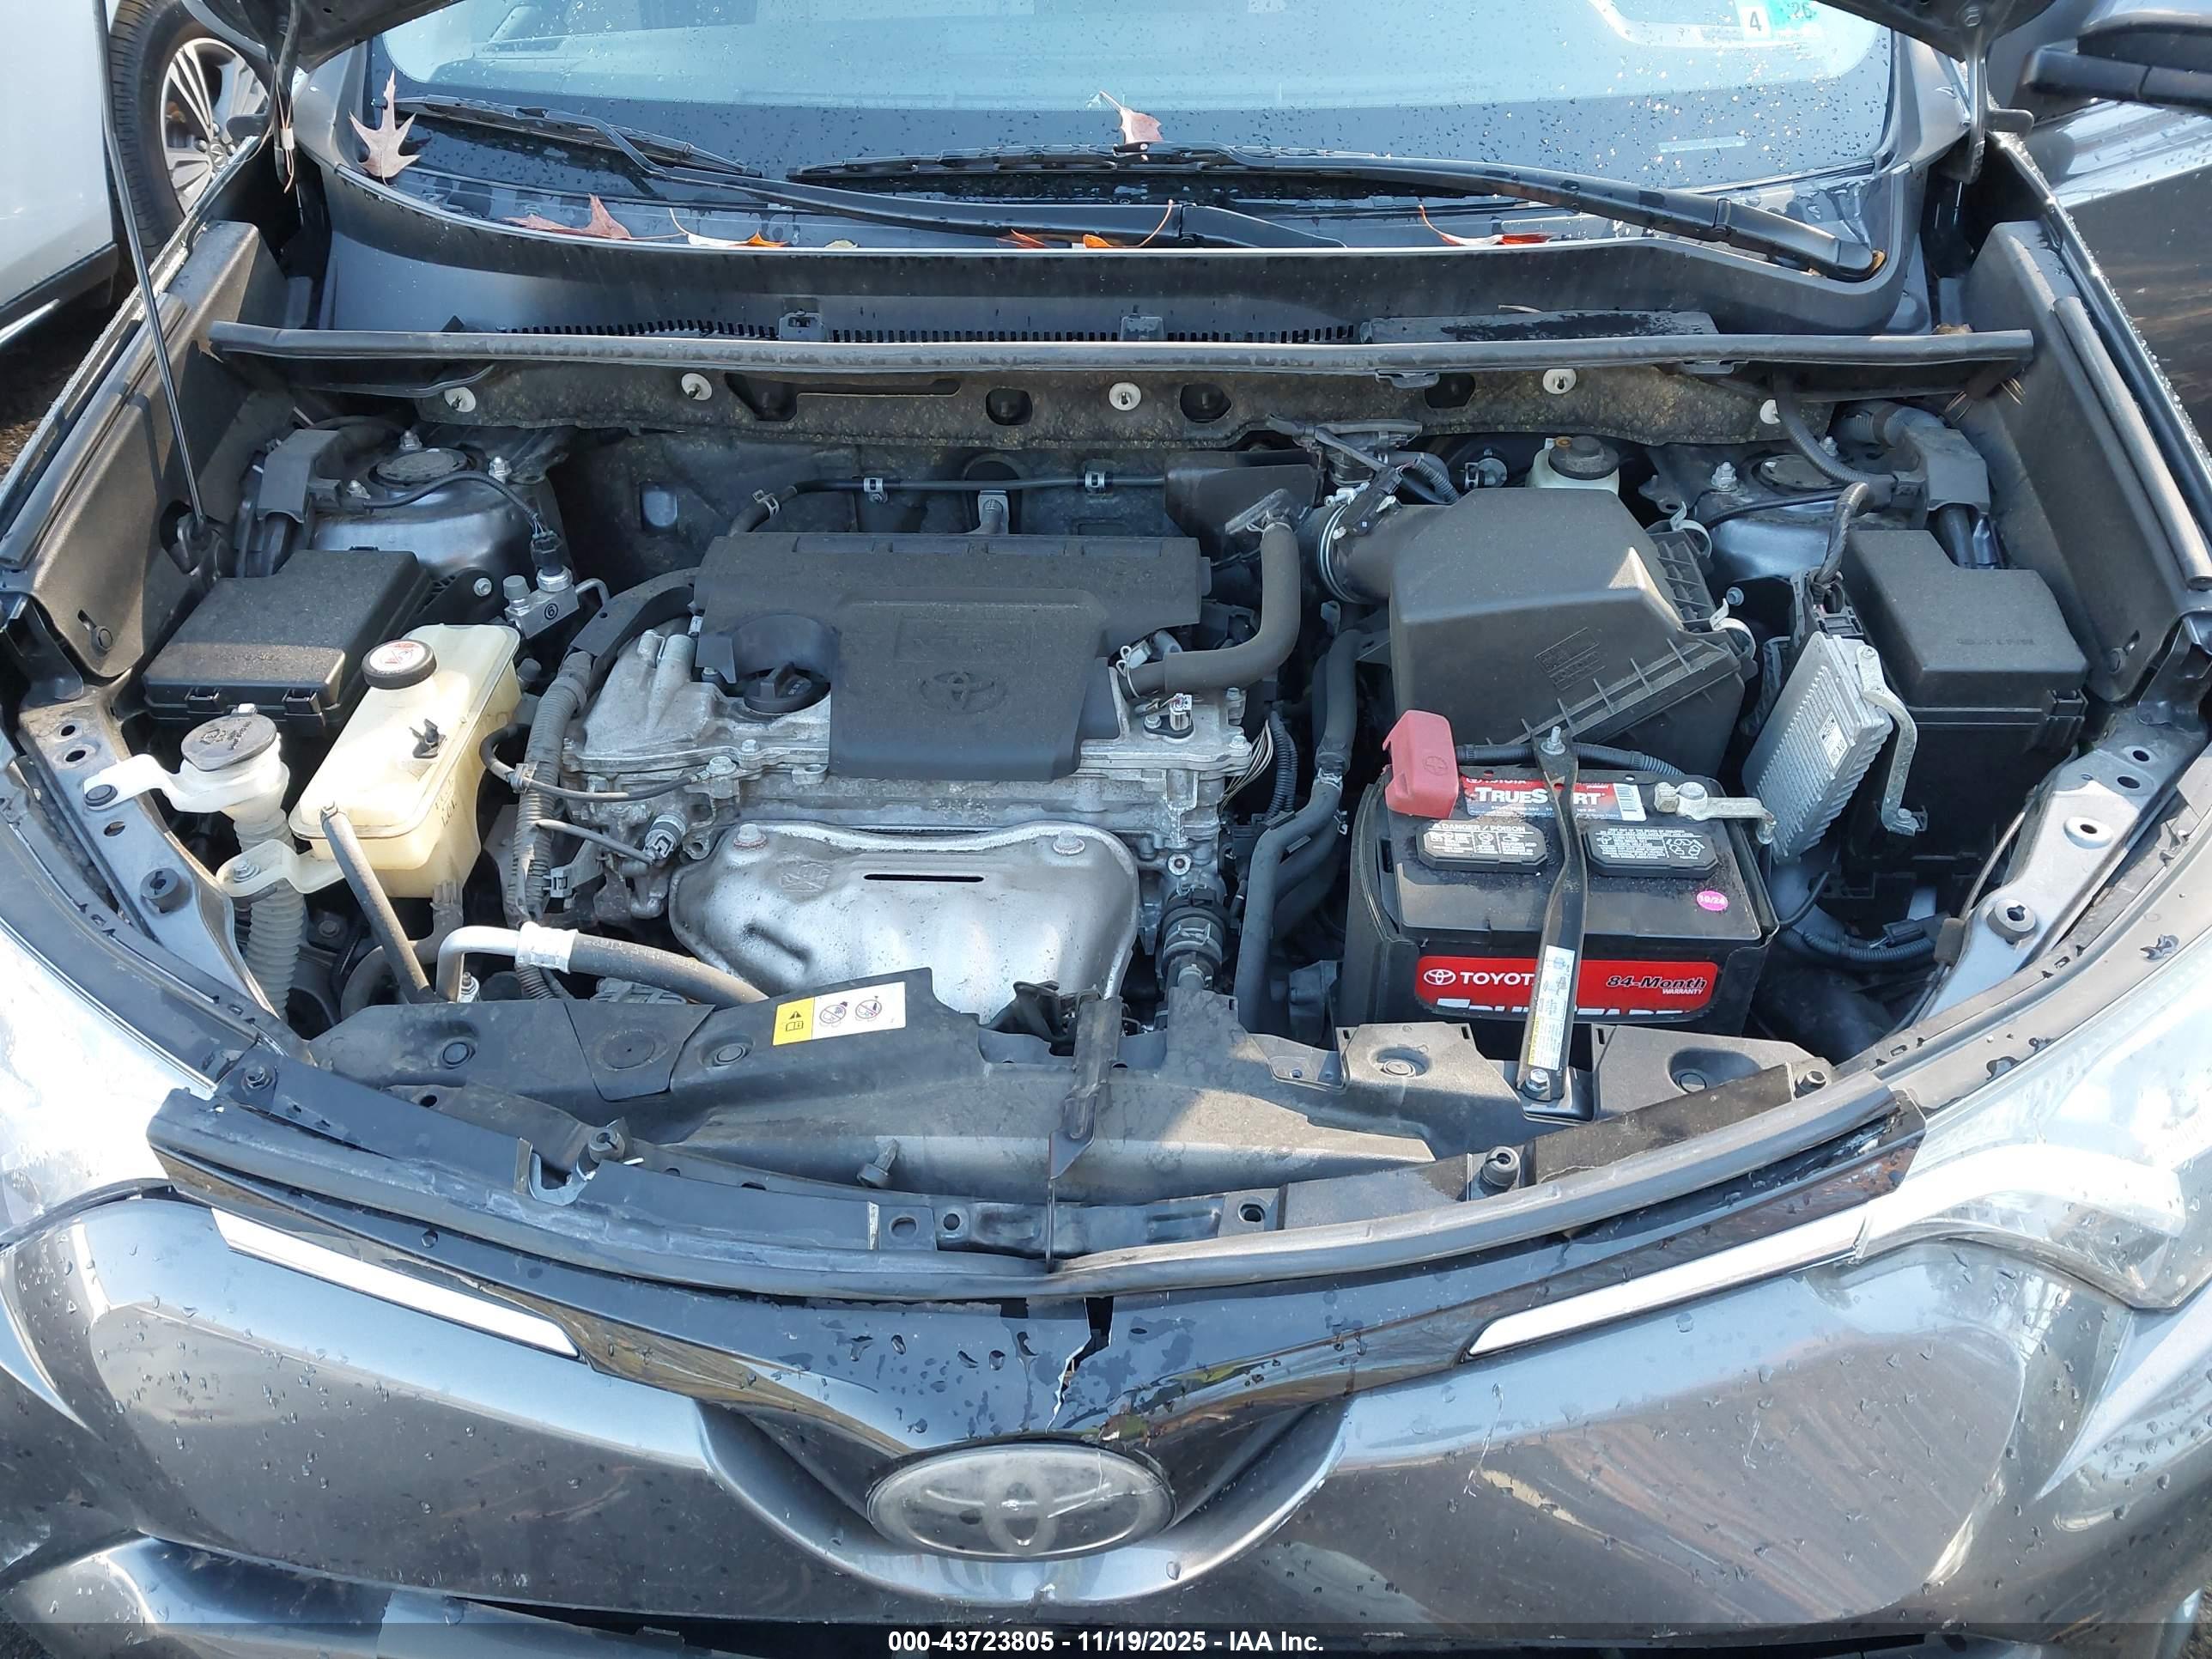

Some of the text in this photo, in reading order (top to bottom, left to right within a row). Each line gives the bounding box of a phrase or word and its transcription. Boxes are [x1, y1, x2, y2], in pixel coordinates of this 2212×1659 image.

[1749, 11, 1762, 31] 4
[1460, 971, 1707, 989] TOYOT 84-Month
